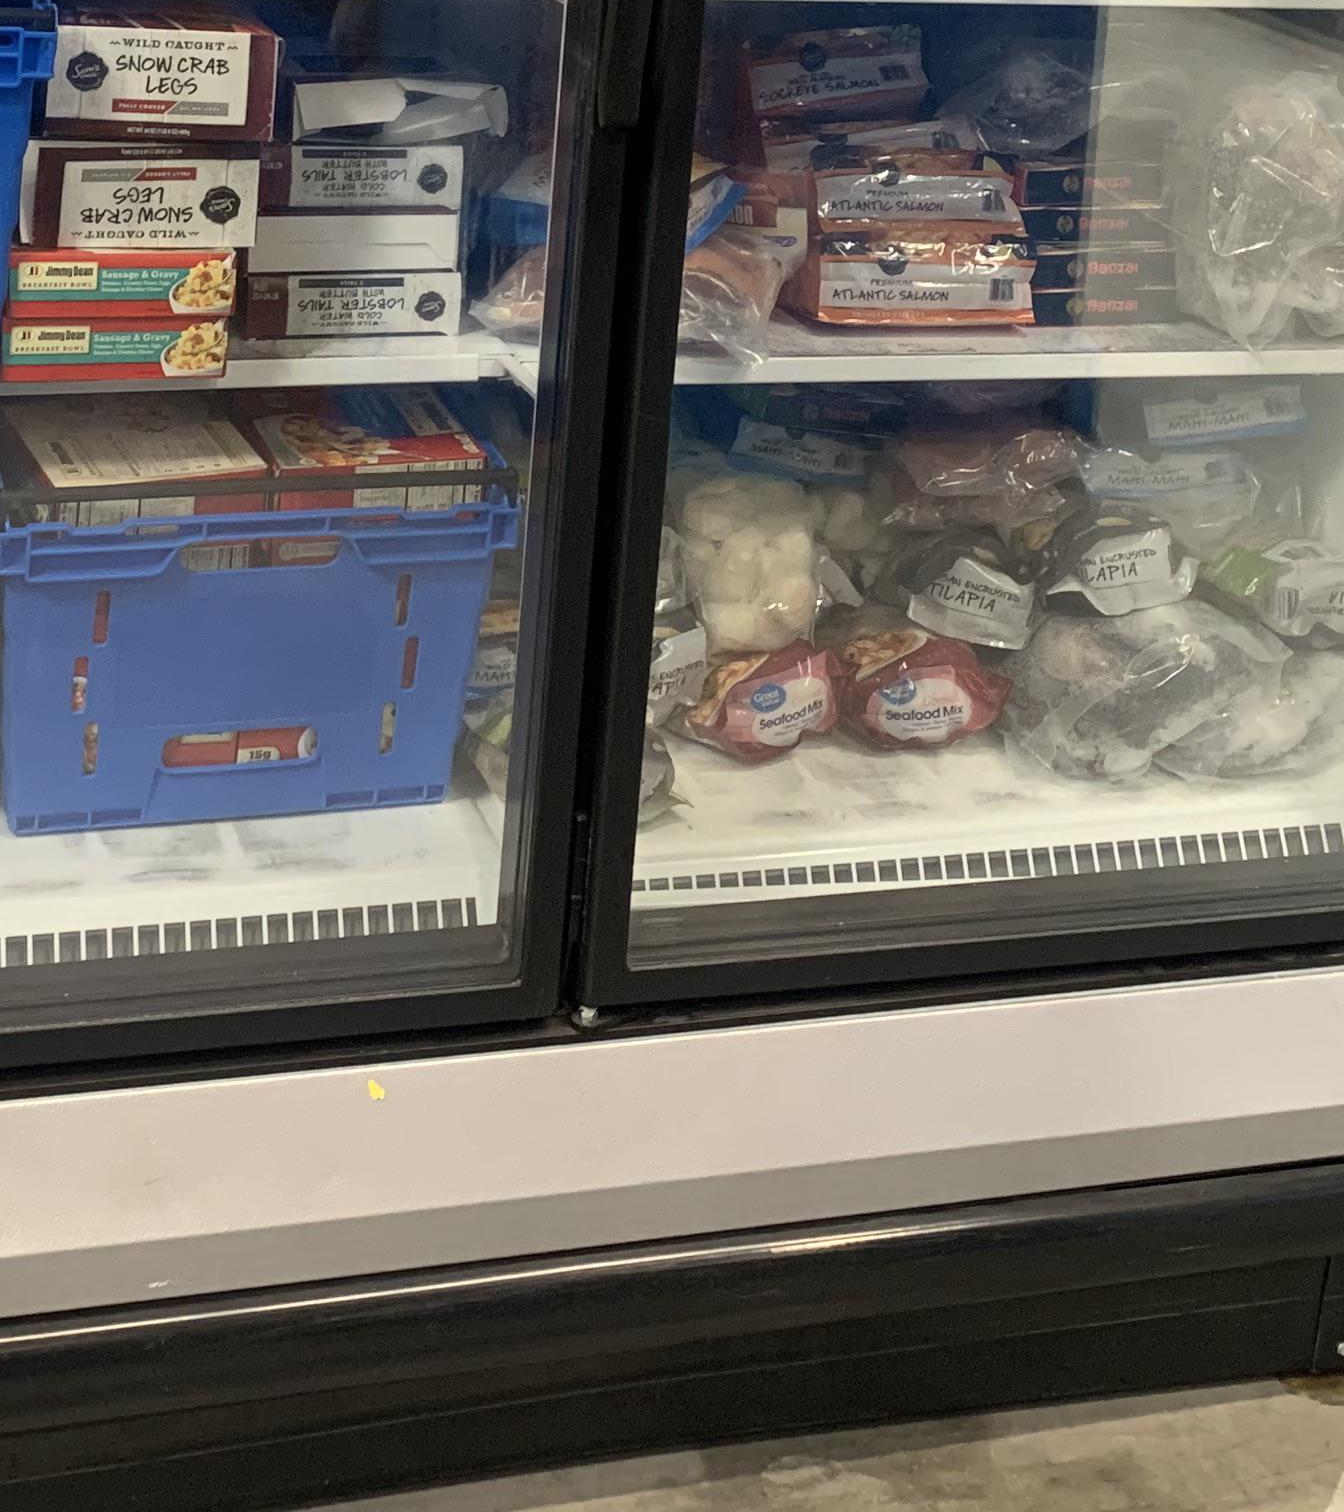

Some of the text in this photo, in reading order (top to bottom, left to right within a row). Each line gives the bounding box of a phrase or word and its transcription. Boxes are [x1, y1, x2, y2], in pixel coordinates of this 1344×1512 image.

[123, 38, 226, 51] WILD CAUGHT
[116, 55, 230, 75] SNOW CRAB
[145, 75, 198, 95] LEGS
[301, 169, 408, 181] LOBSTER TAILS
[113, 187, 164, 204] LEGS
[830, 200, 944, 213] ATLANTIC SALMON
[81, 207, 193, 224] SNOW CRAB
[84, 230, 187, 239] WILD CAUGHT
[46, 267, 93, 277] Jimmy Dean
[102, 271, 140, 280] Sausage
[151, 271, 179, 280] Gravy
[833, 288, 949, 302] ATLANTIC SALMON
[298, 298, 405, 310] LOBSTER TAILS
[38, 330, 86, 341] Jimmy Dean
[94, 334, 131, 343] Sausage
[142, 333, 171, 343] Gravy
[928, 581, 997, 613] TILAPIA
[885, 706, 940, 722] Seafood
